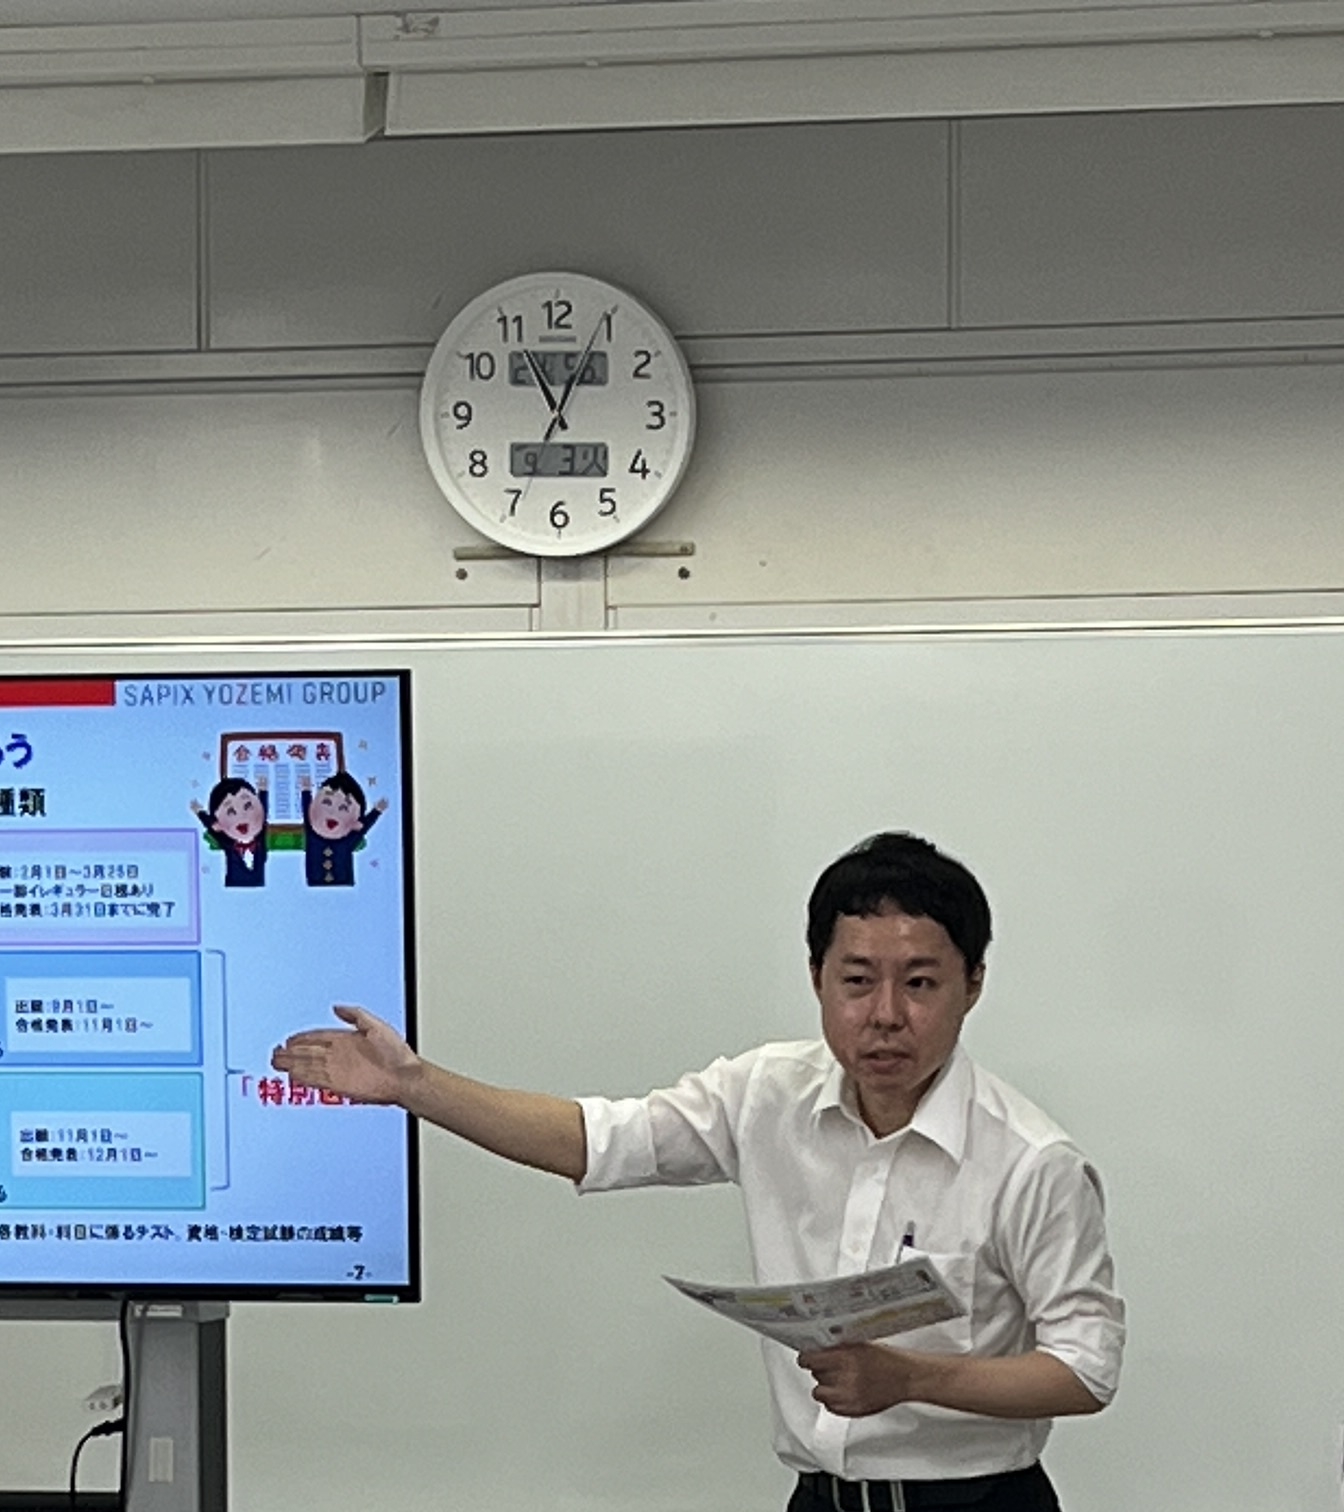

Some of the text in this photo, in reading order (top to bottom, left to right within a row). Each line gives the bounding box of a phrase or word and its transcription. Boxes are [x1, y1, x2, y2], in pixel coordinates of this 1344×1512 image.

[497, 315, 523, 343] 11
[541, 300, 573, 330] 12
[603, 312, 613, 343] 1
[467, 351, 496, 381] 10
[632, 350, 652, 379] 2
[453, 400, 473, 430] 9
[645, 400, 666, 431] 3
[468, 450, 488, 478] 8
[628, 449, 651, 480] 4
[504, 488, 523, 517] 7
[549, 501, 570, 529] 6
[598, 487, 617, 516] 5
[123, 680, 387, 707] SAPIX YOZEMI GROUP
